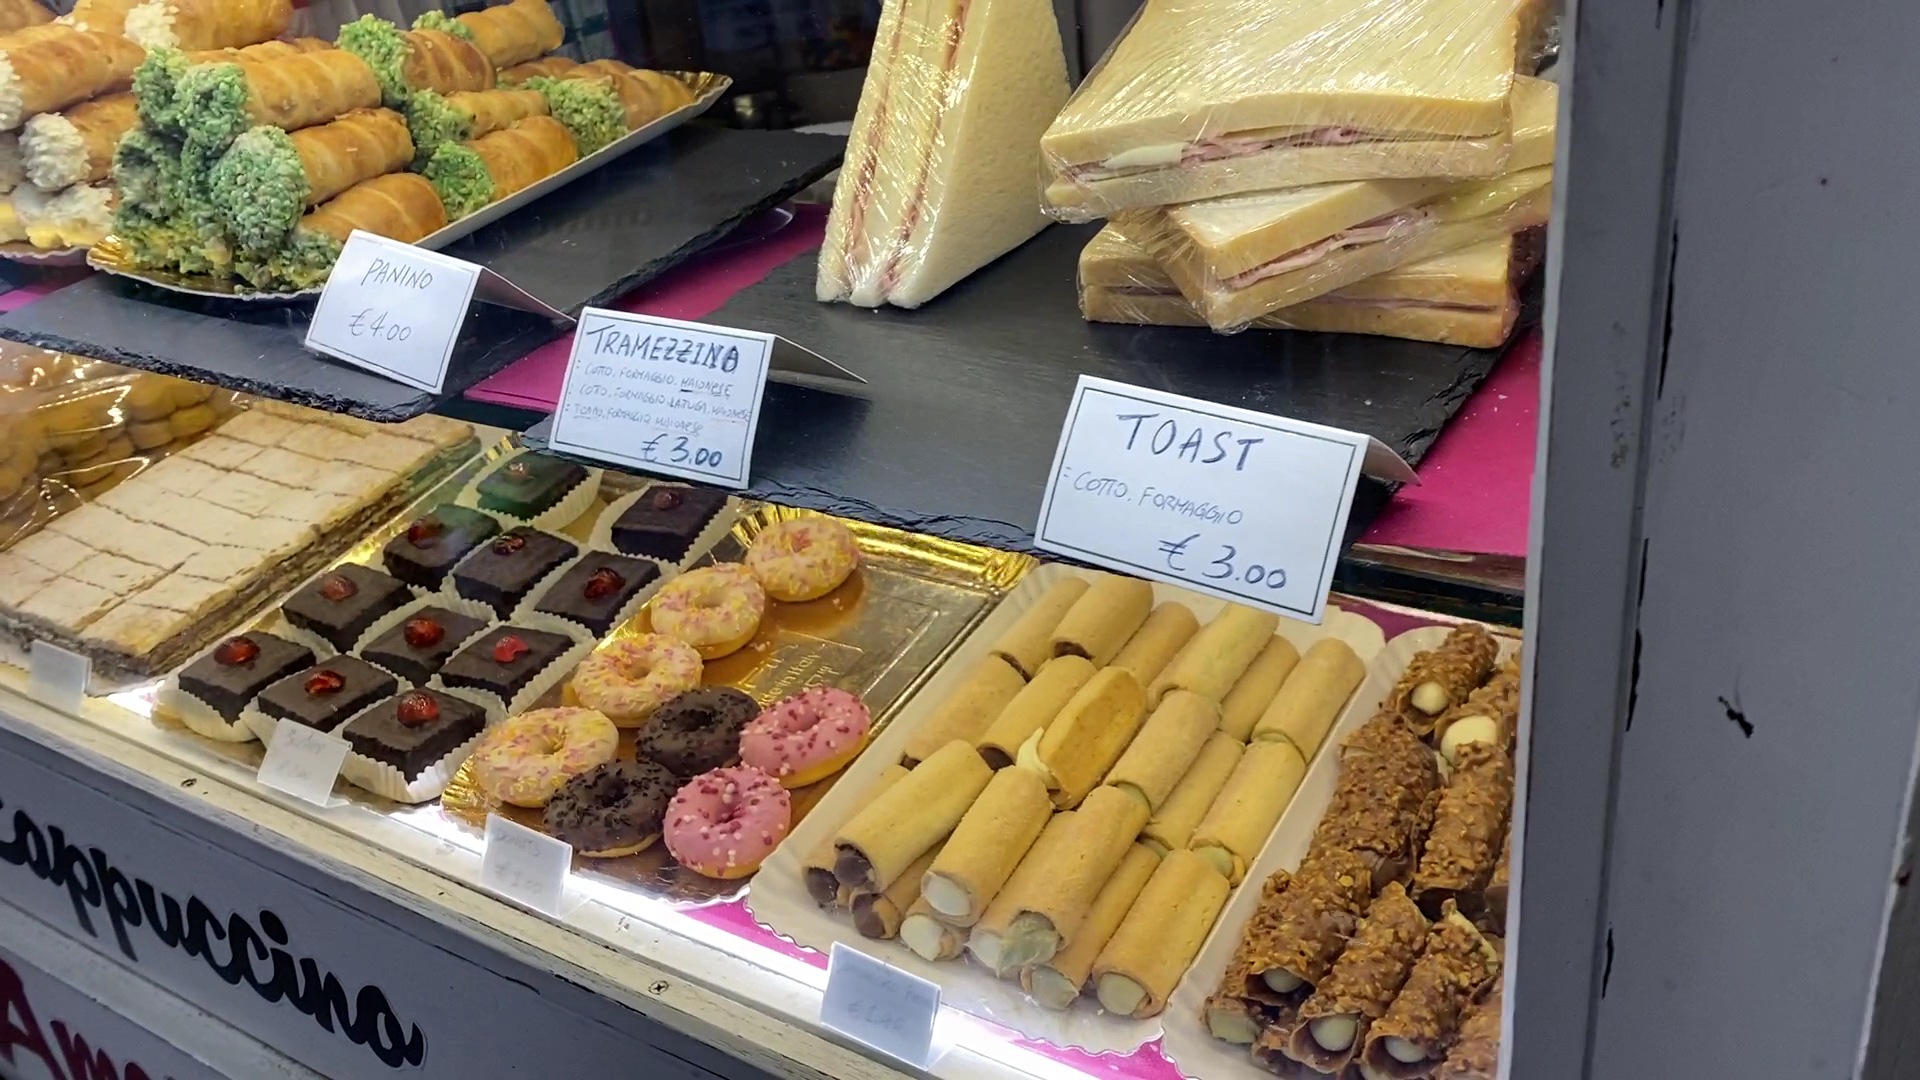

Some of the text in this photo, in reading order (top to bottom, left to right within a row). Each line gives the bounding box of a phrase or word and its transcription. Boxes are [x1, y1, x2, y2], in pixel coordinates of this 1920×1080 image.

[361, 257, 433, 289] PANINO
[1116, 413, 1264, 470] TOAST
[1138, 486, 1243, 525] FORMAGGIO
